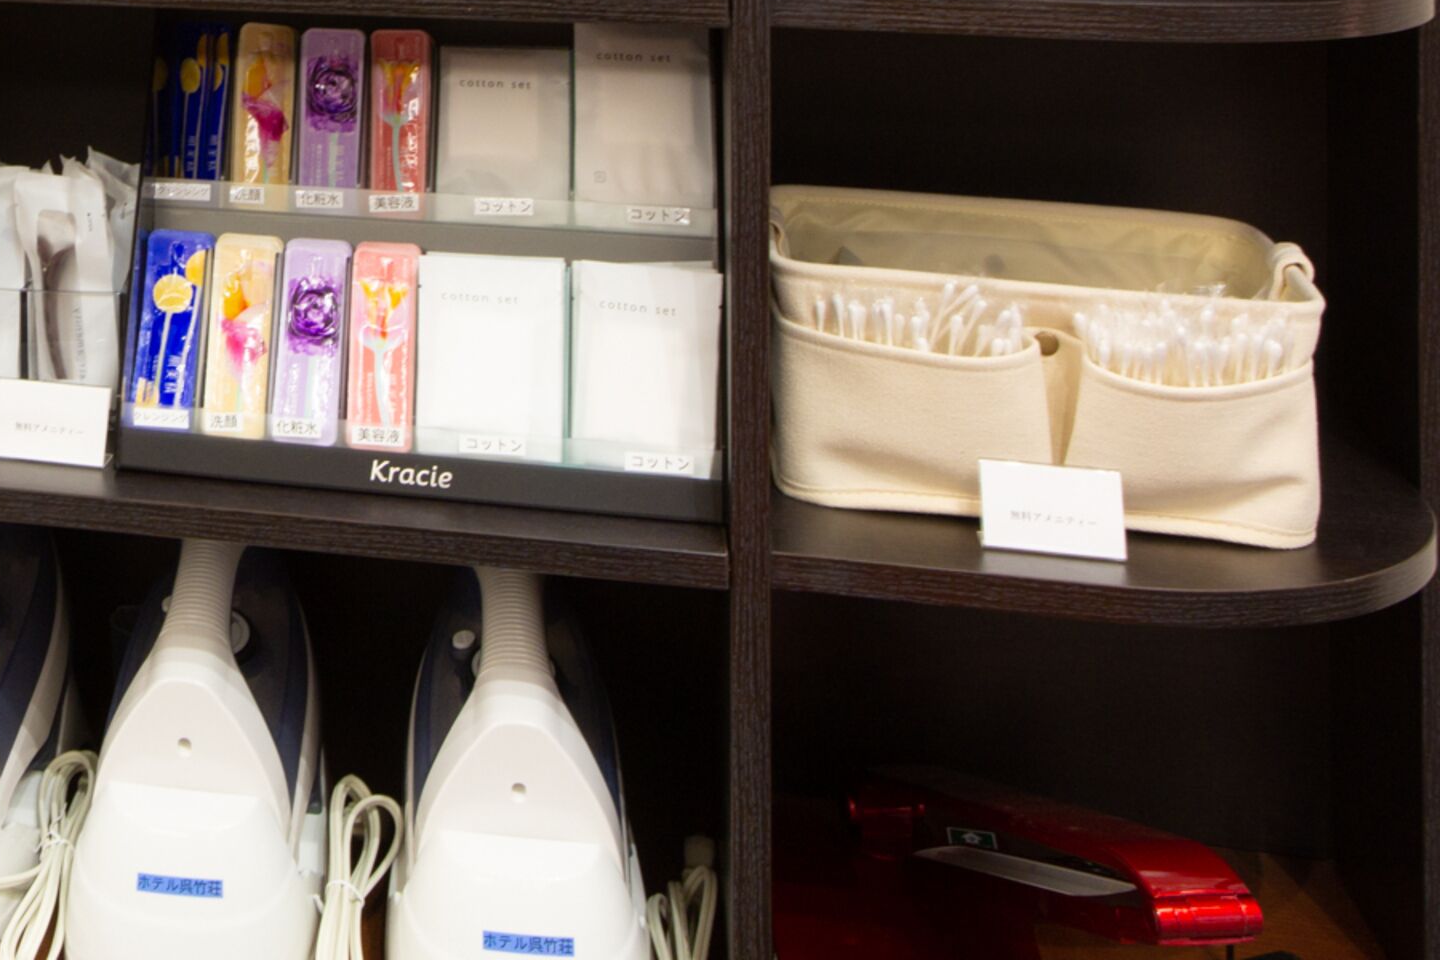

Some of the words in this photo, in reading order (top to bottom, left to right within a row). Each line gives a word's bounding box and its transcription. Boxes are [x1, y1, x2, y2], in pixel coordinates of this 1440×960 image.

[596, 50, 643, 63] cotton
[650, 52, 672, 63] set
[459, 78, 505, 88] cotton
[511, 80, 532, 90] set
[300, 194, 340, 207] 化粧水
[373, 197, 416, 210] 美容液
[478, 200, 532, 213] コットン
[630, 208, 689, 222] コットン
[440, 290, 489, 303] cotton
[497, 293, 519, 305] set
[599, 298, 648, 313] cotton
[655, 305, 678, 317] set
[210, 414, 238, 428] 洗顔
[276, 420, 318, 435] 化粧水
[358, 427, 400, 444] 美容液
[466, 438, 522, 453] コットン
[632, 454, 690, 470] コットン
[370, 459, 454, 489] Kracie
[138, 875, 223, 897] ホテル呉竹荘
[483, 933, 574, 956] ホテル呉竹荘
